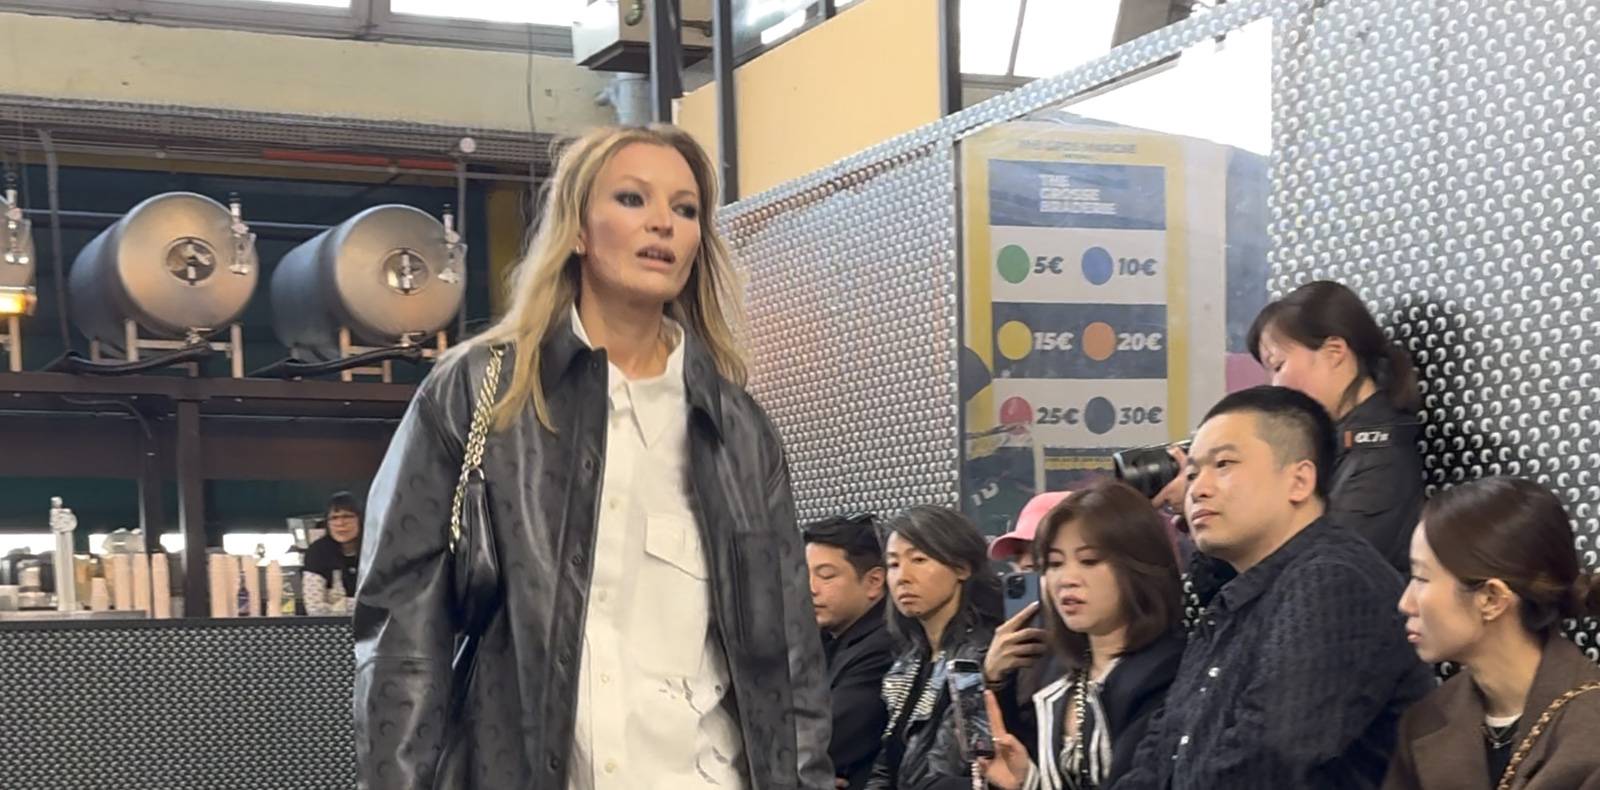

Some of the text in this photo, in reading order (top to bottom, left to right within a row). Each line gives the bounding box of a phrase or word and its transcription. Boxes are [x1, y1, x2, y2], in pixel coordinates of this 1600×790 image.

[1039, 174, 1070, 187] THE
[1034, 256, 1157, 276] 5€ 10€
[1034, 332, 1162, 350] 15€ 20€
[1036, 406, 1162, 424] 25€ 30€
